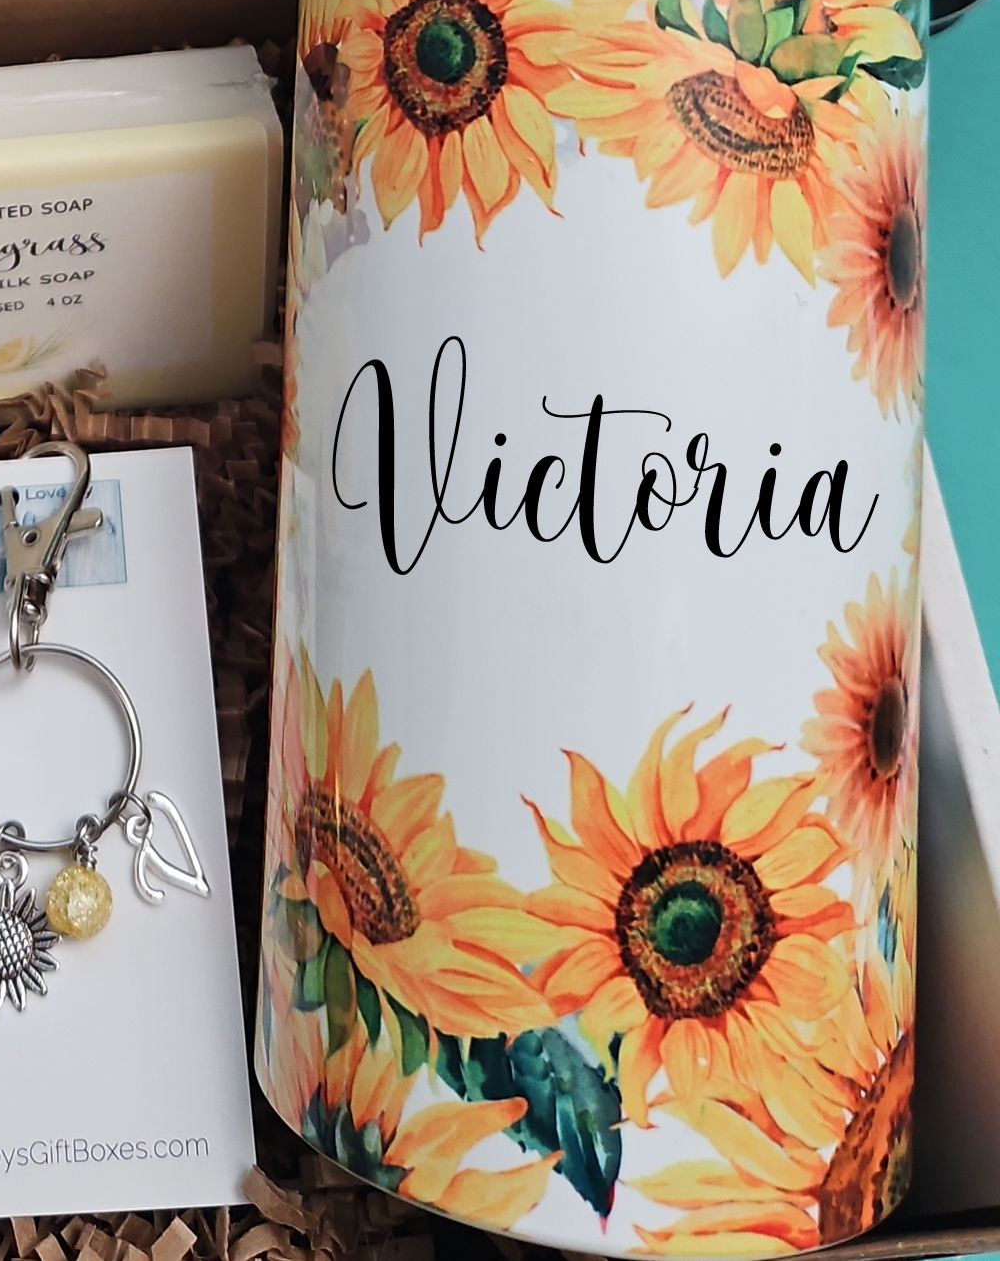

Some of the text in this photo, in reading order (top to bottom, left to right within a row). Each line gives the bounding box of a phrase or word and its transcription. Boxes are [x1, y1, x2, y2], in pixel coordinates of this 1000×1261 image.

[40, 197, 94, 216] SOAP
[38, 269, 96, 286] SOAP
[46, 297, 56, 308] 4
[61, 294, 84, 306] OZ
[333, 336, 880, 576] Victoria
[25, 487, 66, 501] Love
